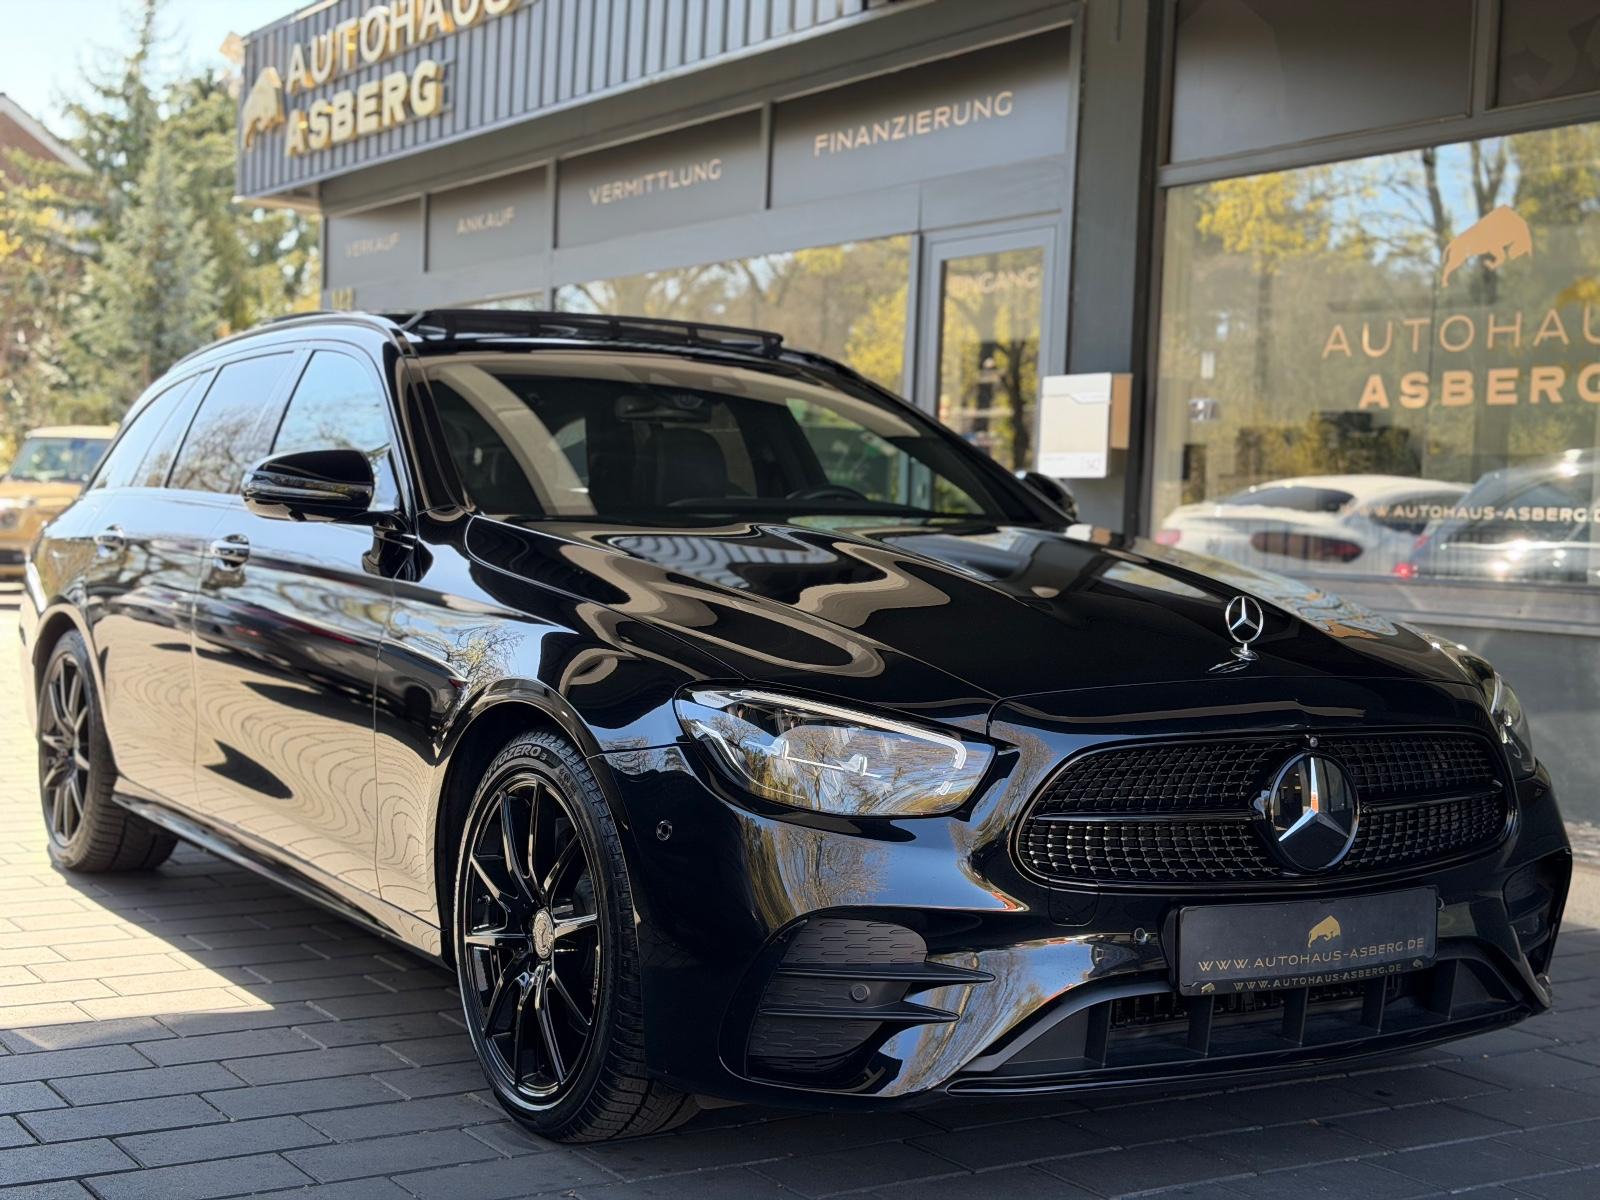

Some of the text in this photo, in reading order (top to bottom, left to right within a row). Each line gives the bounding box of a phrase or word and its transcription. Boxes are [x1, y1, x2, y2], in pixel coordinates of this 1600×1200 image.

[285, 59, 443, 157] ASBERG
[814, 91, 1013, 156] FINANZIERUNG
[589, 158, 722, 205] VERMITTLUNG
[456, 206, 515, 234] ANKAUF
[1359, 364, 1600, 410] ASBERG
[1198, 938, 1425, 972] WWW.AUTOHAUS-ASBERG.DE
[1234, 964, 1402, 991] WWW.AUTOHAUS-ASBERG.DE
